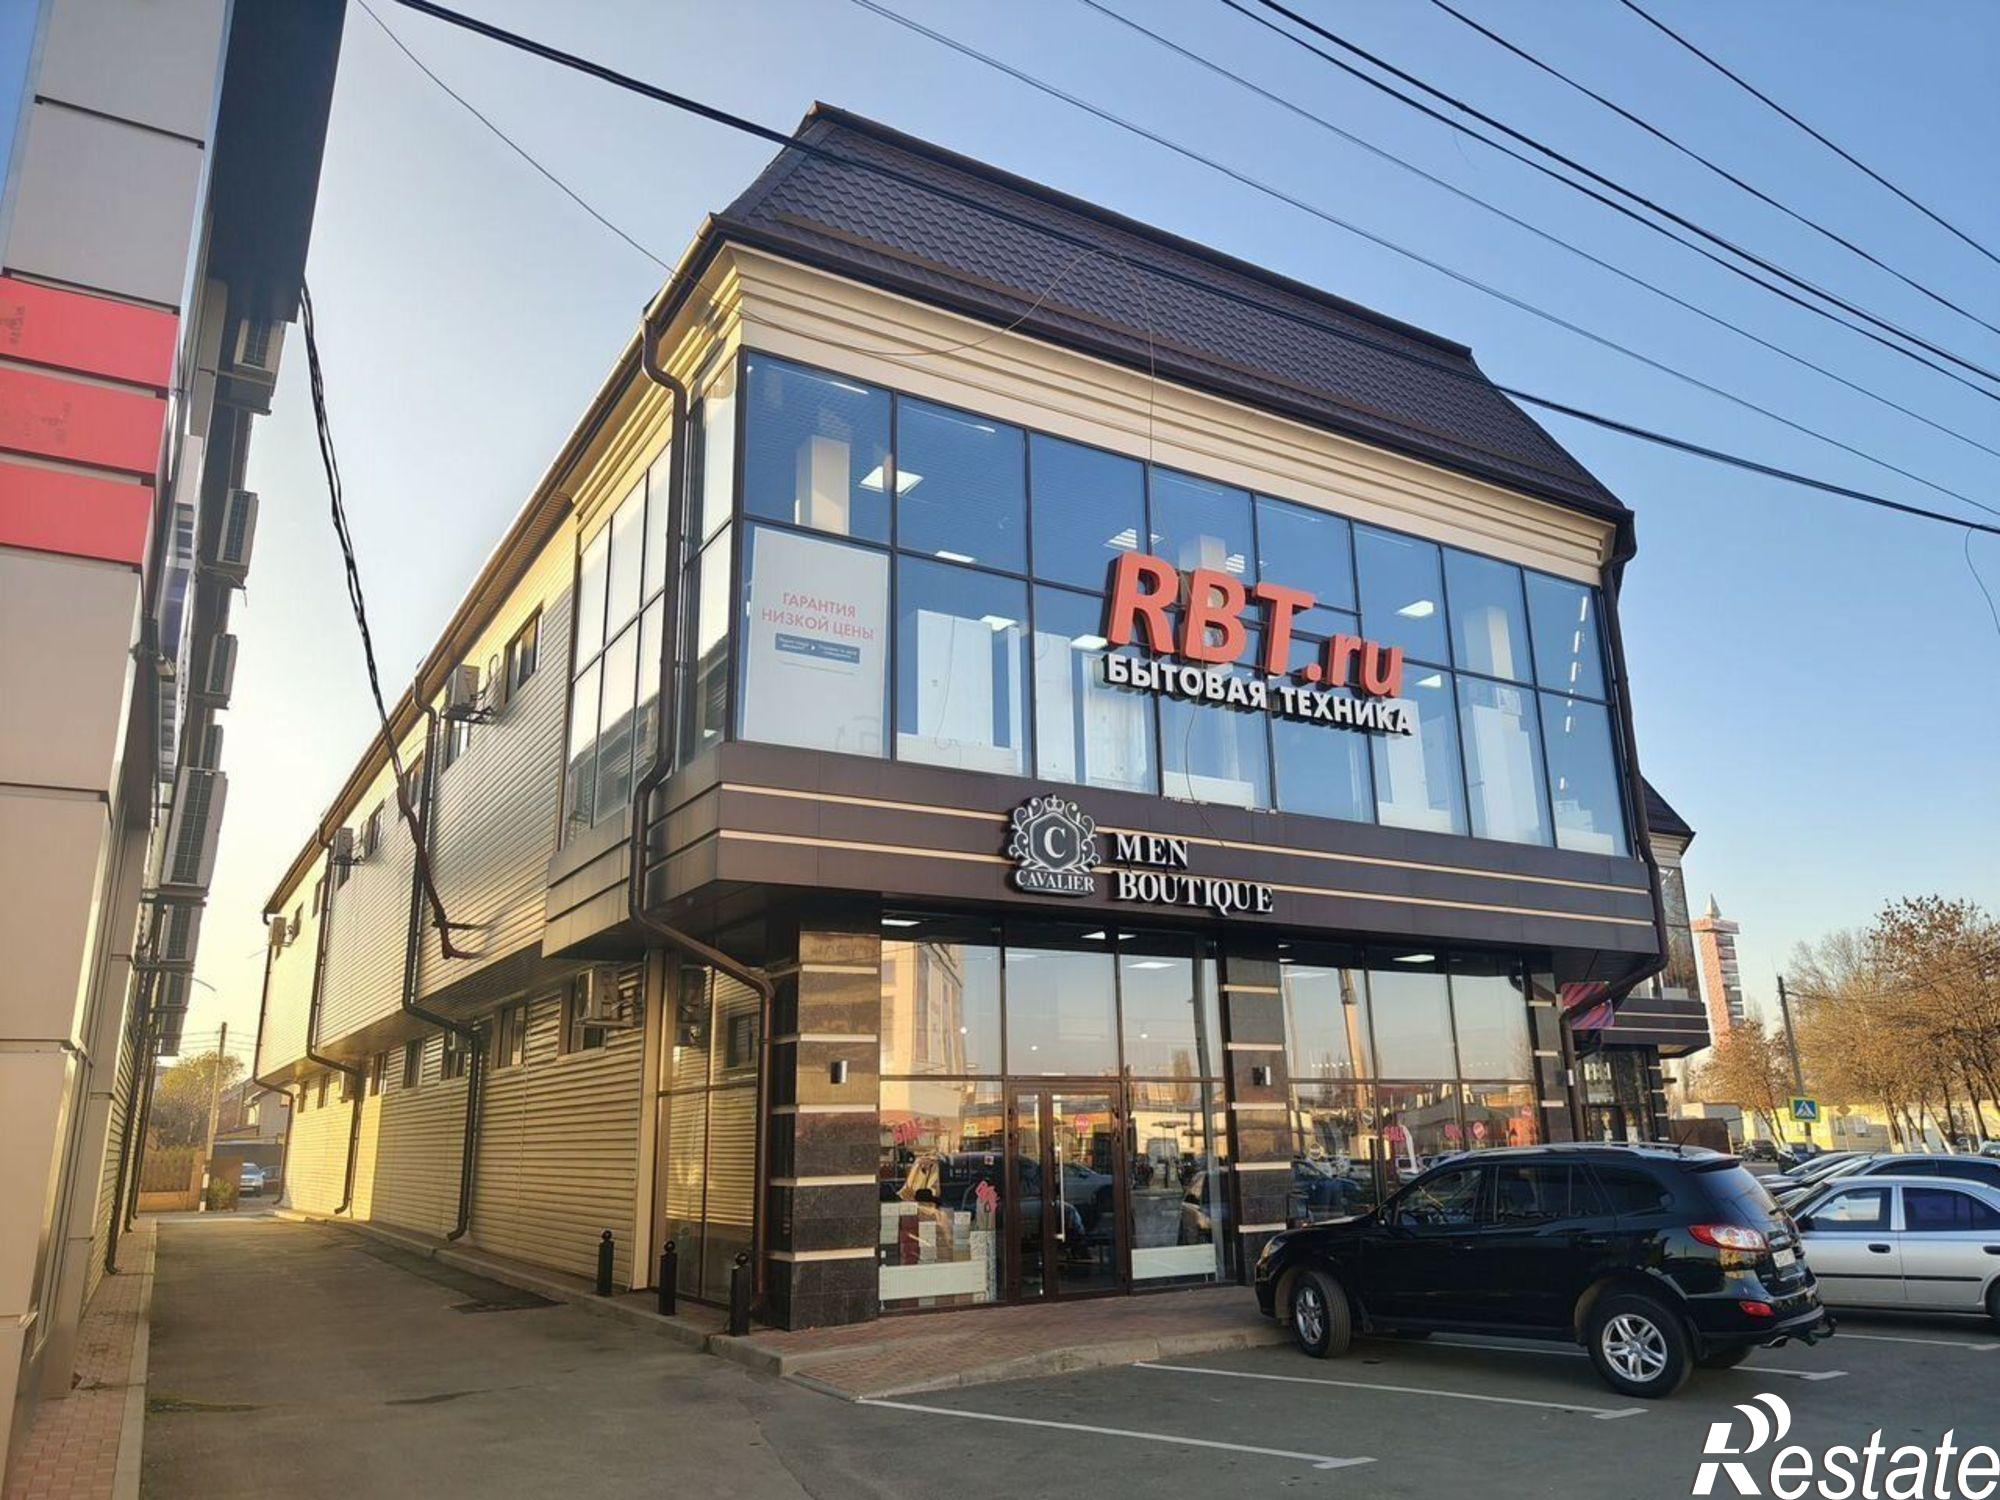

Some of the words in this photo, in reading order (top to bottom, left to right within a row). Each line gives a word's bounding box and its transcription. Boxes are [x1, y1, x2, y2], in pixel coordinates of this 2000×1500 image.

[782, 593, 856, 618] ГАРАНТИЯ
[761, 608, 829, 631] НИЗКОЙ
[833, 622, 875, 641] ЦЕНЫ
[1108, 552, 1404, 697] RBT.ru
[1107, 654, 1267, 709] БЫТОВАЯ
[1280, 686, 1414, 736] ТЕХНИКА
[1043, 826, 1066, 859] C
[1115, 833, 1189, 867] MEN
[1014, 870, 1096, 893] CAVALIER
[1117, 871, 1274, 917] BOUTIQUE
